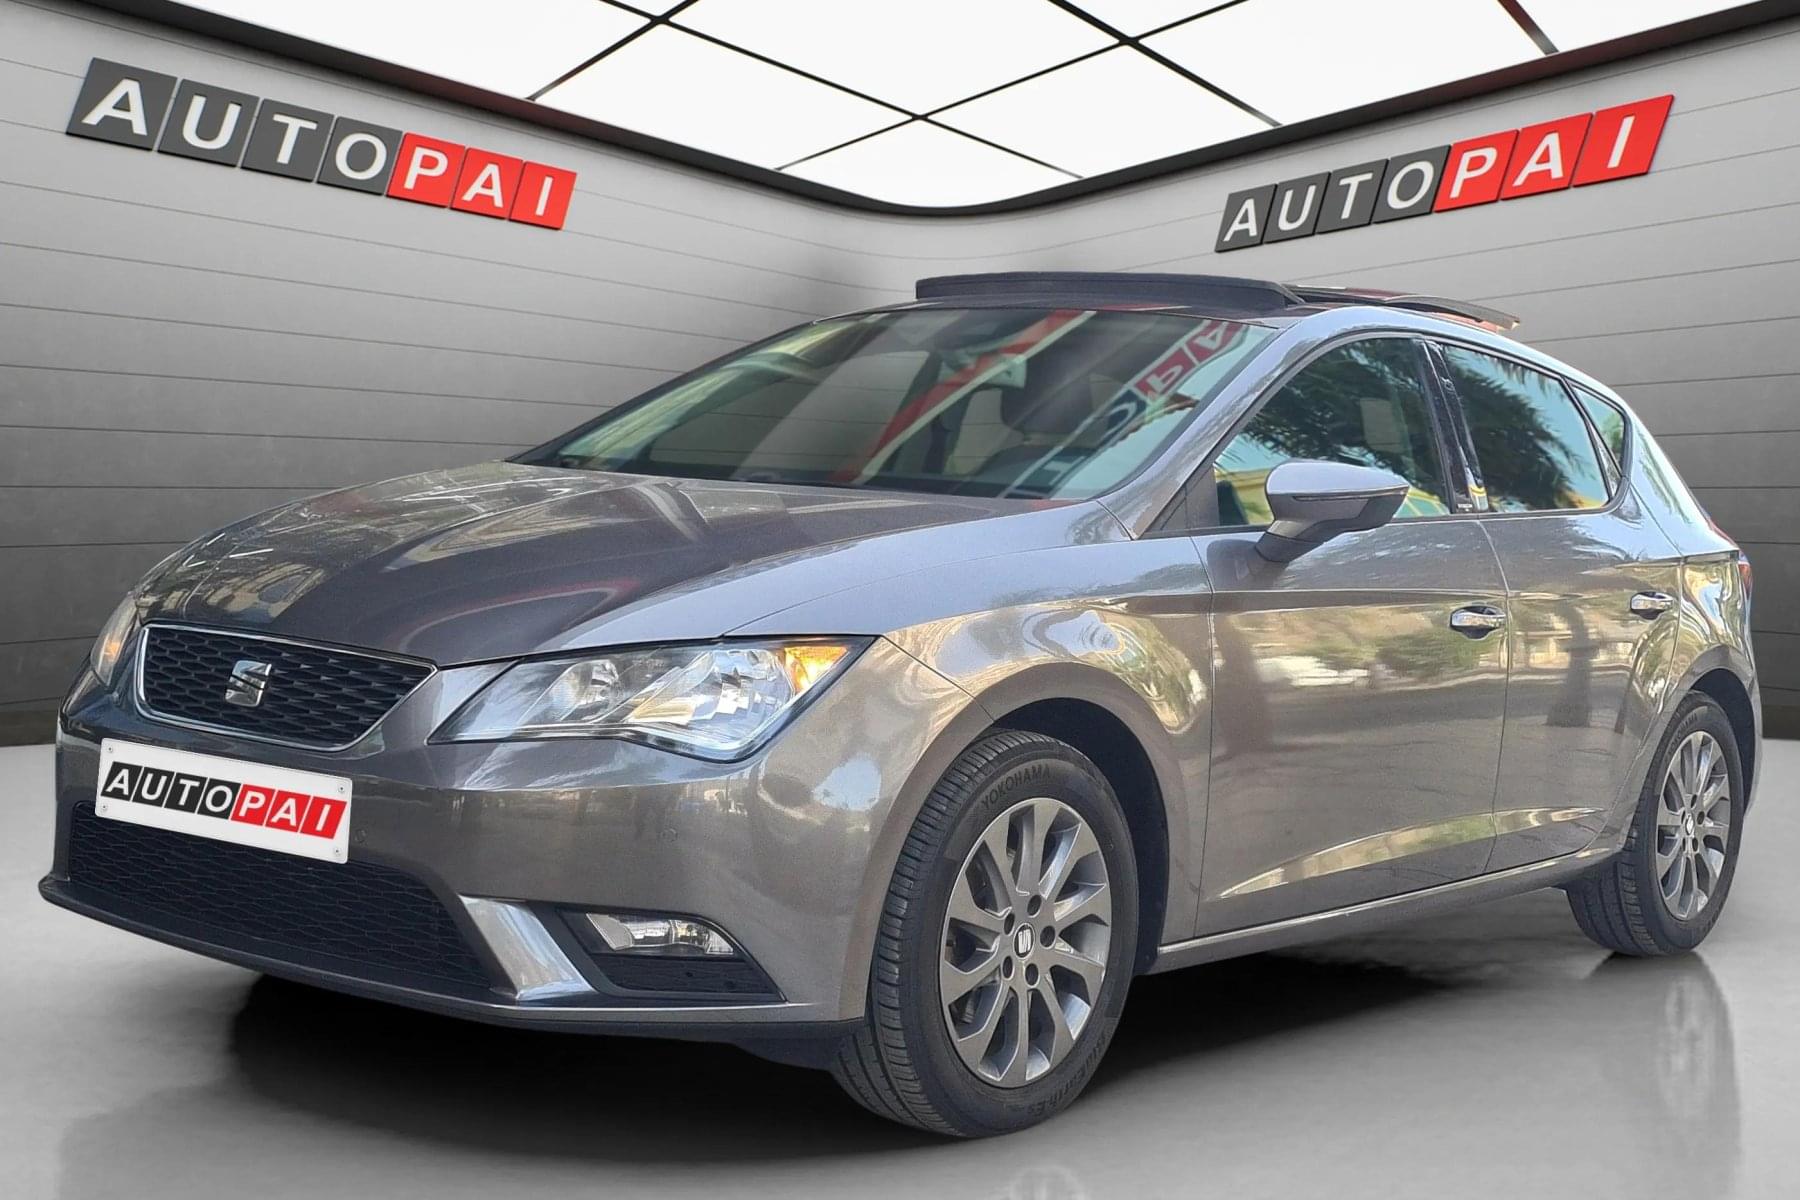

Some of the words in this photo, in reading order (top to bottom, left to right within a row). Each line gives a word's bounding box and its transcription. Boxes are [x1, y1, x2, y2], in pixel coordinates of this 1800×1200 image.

[82, 77, 554, 217] AUTOPAI
[1223, 115, 1634, 242] AUTOPAI
[105, 768, 331, 831] AUTOPAI
[981, 763, 1051, 809] YOKOHAMA
